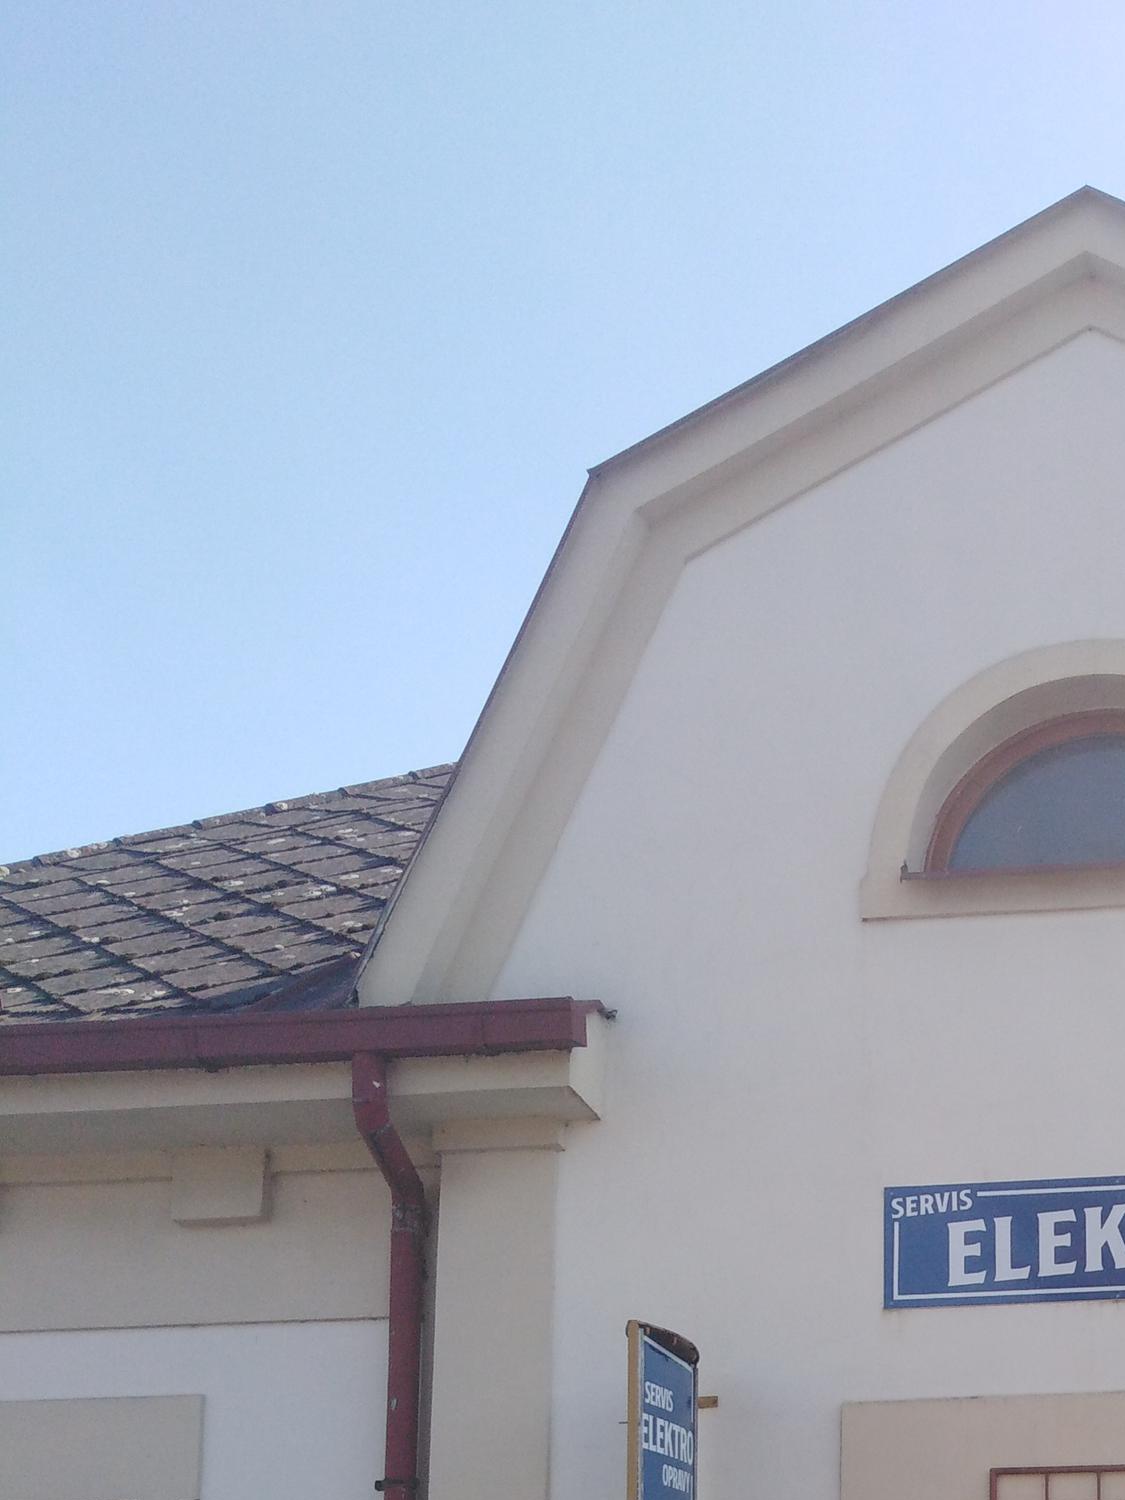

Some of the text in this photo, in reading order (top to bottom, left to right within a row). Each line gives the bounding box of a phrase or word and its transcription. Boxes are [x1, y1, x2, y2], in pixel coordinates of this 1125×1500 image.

[891, 1189, 973, 1219] SERVIS
[644, 1381, 674, 1413] SERVIS
[641, 1413, 694, 1466] ELEKTRO
[662, 1463, 691, 1494] OPRAVY
